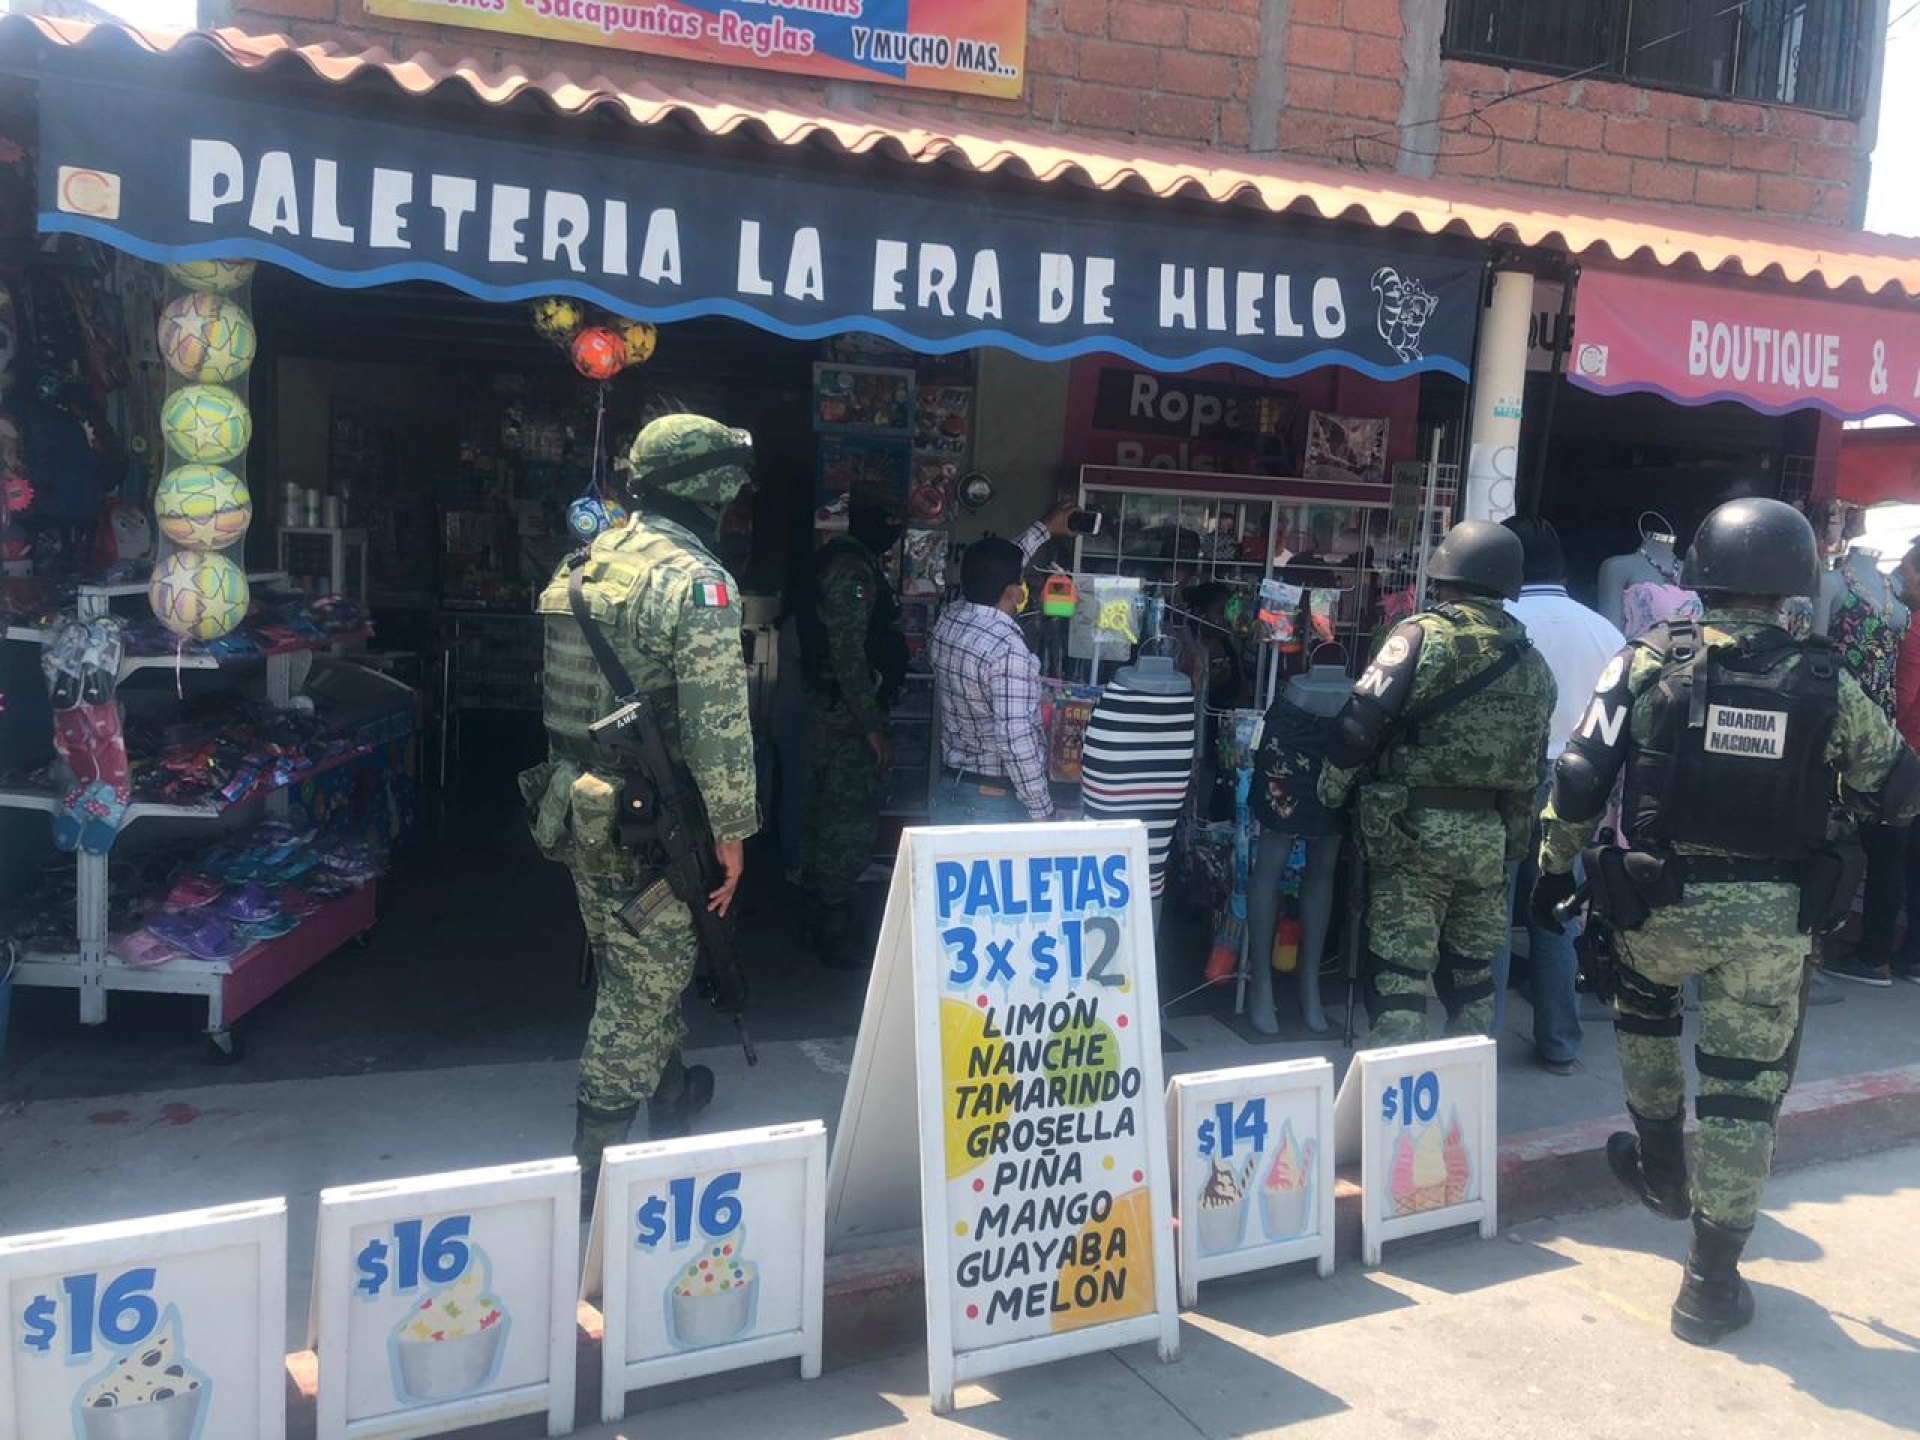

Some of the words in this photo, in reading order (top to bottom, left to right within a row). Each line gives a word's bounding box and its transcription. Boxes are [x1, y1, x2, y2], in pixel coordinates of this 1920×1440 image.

[853, 28, 869, 57] Y
[873, 31, 950, 67] MUCHO
[189, 138, 682, 286] PALETERIA
[736, 219, 826, 302] LA
[872, 238, 1003, 323] ERA
[1038, 251, 1116, 326] DE
[1159, 262, 1348, 339] HIELO
[1688, 320, 1840, 389] BOUTIQUE
[1869, 338, 1888, 397] &
[1710, 731, 1777, 755] NACIONAL
[1718, 710, 1776, 732] GUARDIA
[935, 854, 1130, 919] PALETAS
[1031, 916, 1126, 988] $12
[982, 992, 1098, 1039] LIMÓN
[967, 1033, 1108, 1079] NANCHE
[955, 1067, 1142, 1120] TAMARINDO
[1382, 1071, 1440, 1126] $10
[966, 1106, 1136, 1159] GROSELLA
[1198, 1098, 1269, 1158] $14
[992, 1149, 1083, 1197] PIÑA
[638, 1172, 743, 1247] $16
[974, 1190, 1114, 1242] MANGO
[357, 1215, 472, 1295] $16
[956, 1227, 1127, 1288] GUAYABA
[24, 1267, 159, 1356] $16
[986, 1265, 1128, 1326] MELÓN
